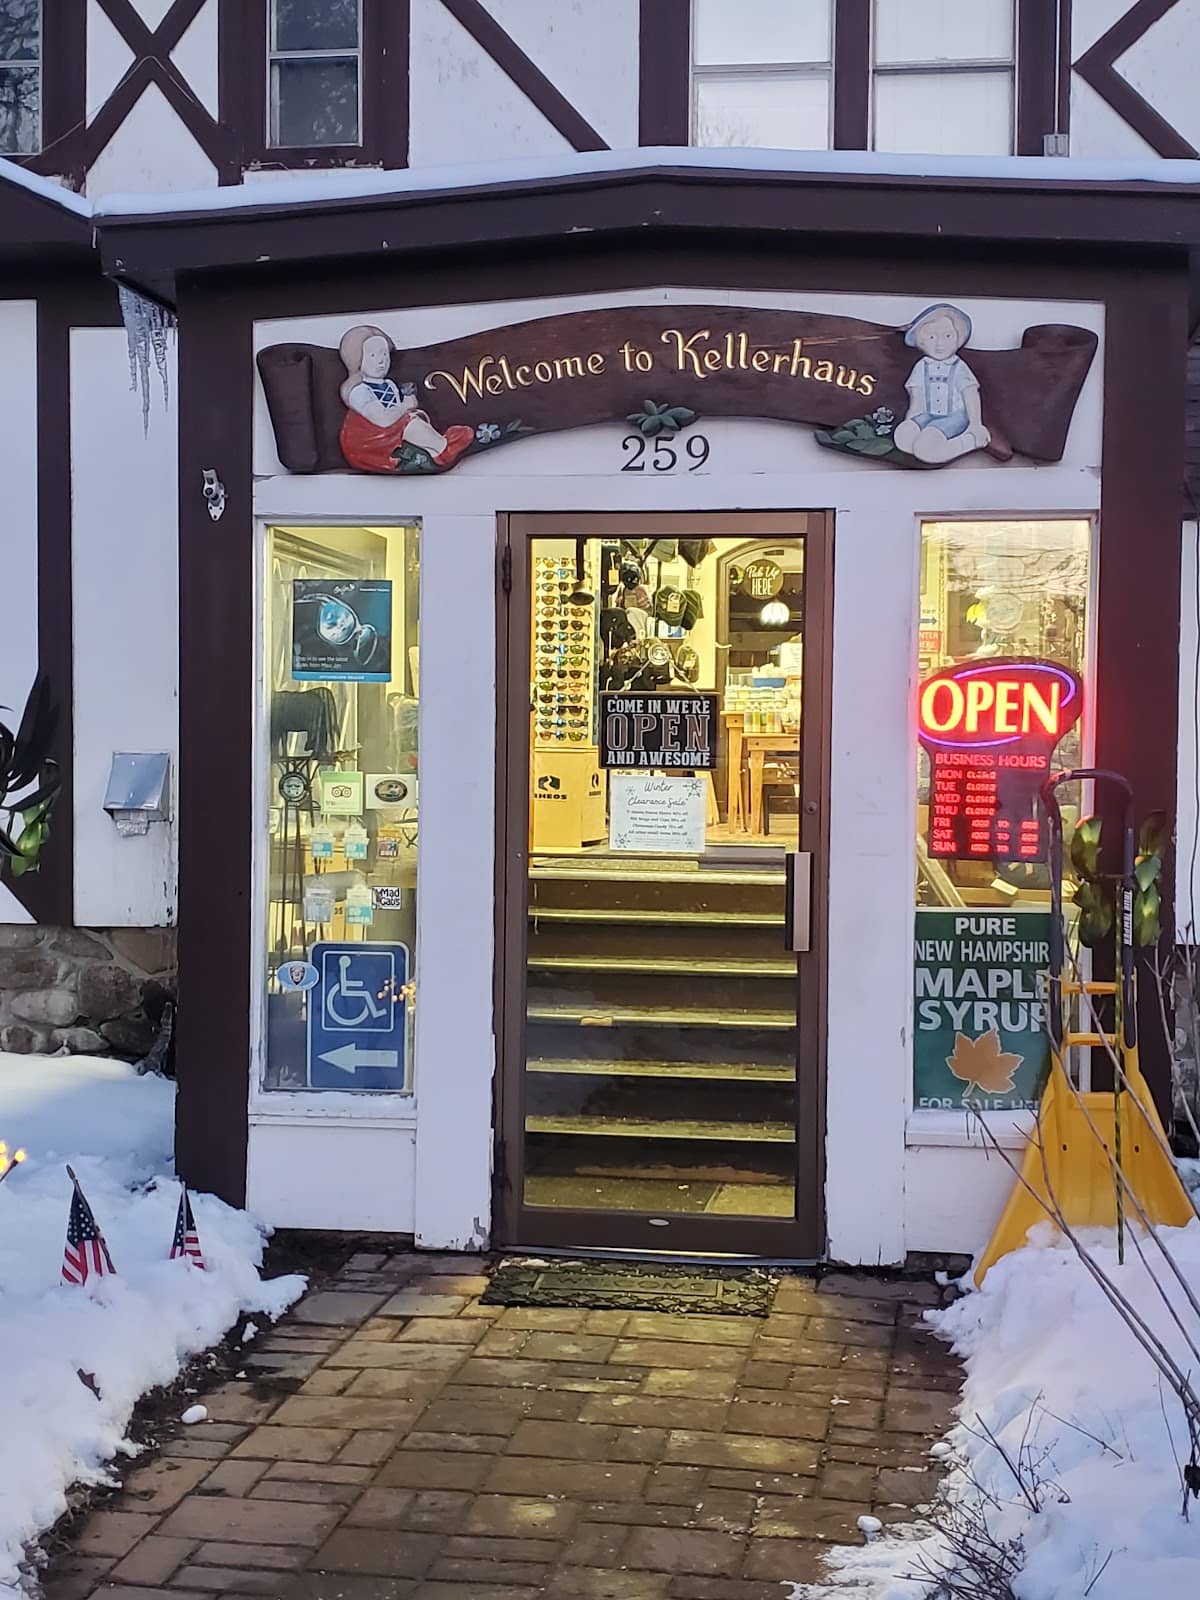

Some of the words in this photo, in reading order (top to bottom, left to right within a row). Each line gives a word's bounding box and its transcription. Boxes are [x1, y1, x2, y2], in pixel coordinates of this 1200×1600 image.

[424, 355, 605, 404] Welcome
[619, 340, 653, 373] to
[661, 329, 877, 396] Kellerhaus
[621, 434, 710, 472] 259
[752, 578, 774, 596] HERE
[607, 699, 644, 714] COME
[648, 700, 661, 714] IN
[921, 679, 1060, 734] OPEN
[606, 713, 710, 751] OPEN
[606, 751, 635, 765] AND
[639, 751, 710, 766] AWESOME
[935, 753, 994, 766] BUSINESS
[998, 755, 1047, 768] HOURS
[935, 770, 962, 779] MON
[644, 780, 673, 792] Winter
[935, 781, 956, 791] TUE
[965, 782, 996, 792] CLOSED
[628, 796, 666, 806] Clearance
[935, 793, 960, 803] WED
[965, 795, 996, 804] CLOSED
[934, 805, 958, 815] THU
[933, 817, 951, 827] FRI
[933, 829, 953, 839] SAT
[932, 841, 957, 852] SUN
[380, 888, 400, 898] Mad
[955, 917, 1016, 936] PURE
[914, 940, 953, 961] NEW
[961, 941, 1050, 963] HAMPSHIR
